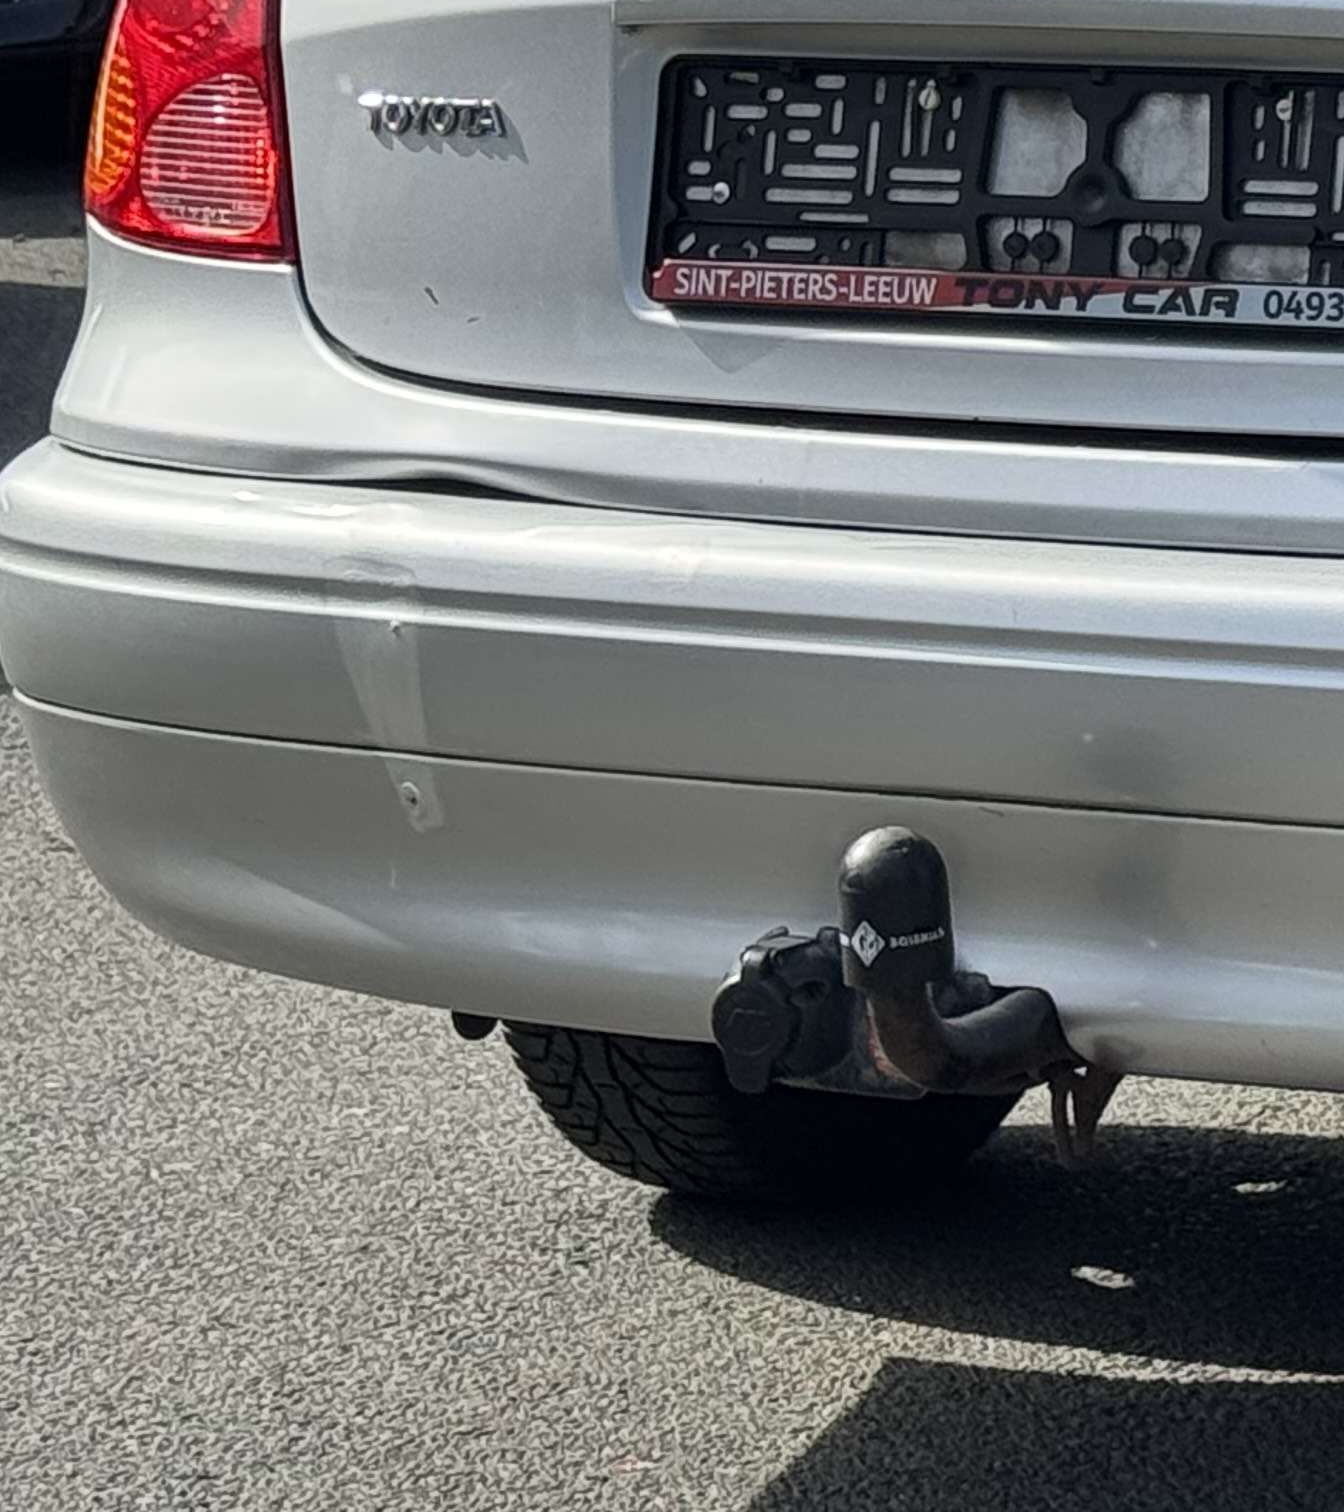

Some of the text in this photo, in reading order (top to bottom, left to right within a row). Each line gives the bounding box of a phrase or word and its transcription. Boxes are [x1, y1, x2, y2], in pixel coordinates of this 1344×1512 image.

[357, 91, 507, 138] TOYOTA
[673, 267, 938, 306] SINT-PIETERS-LEEUW
[954, 278, 1107, 313] TONY
[1121, 287, 1241, 319] CAR
